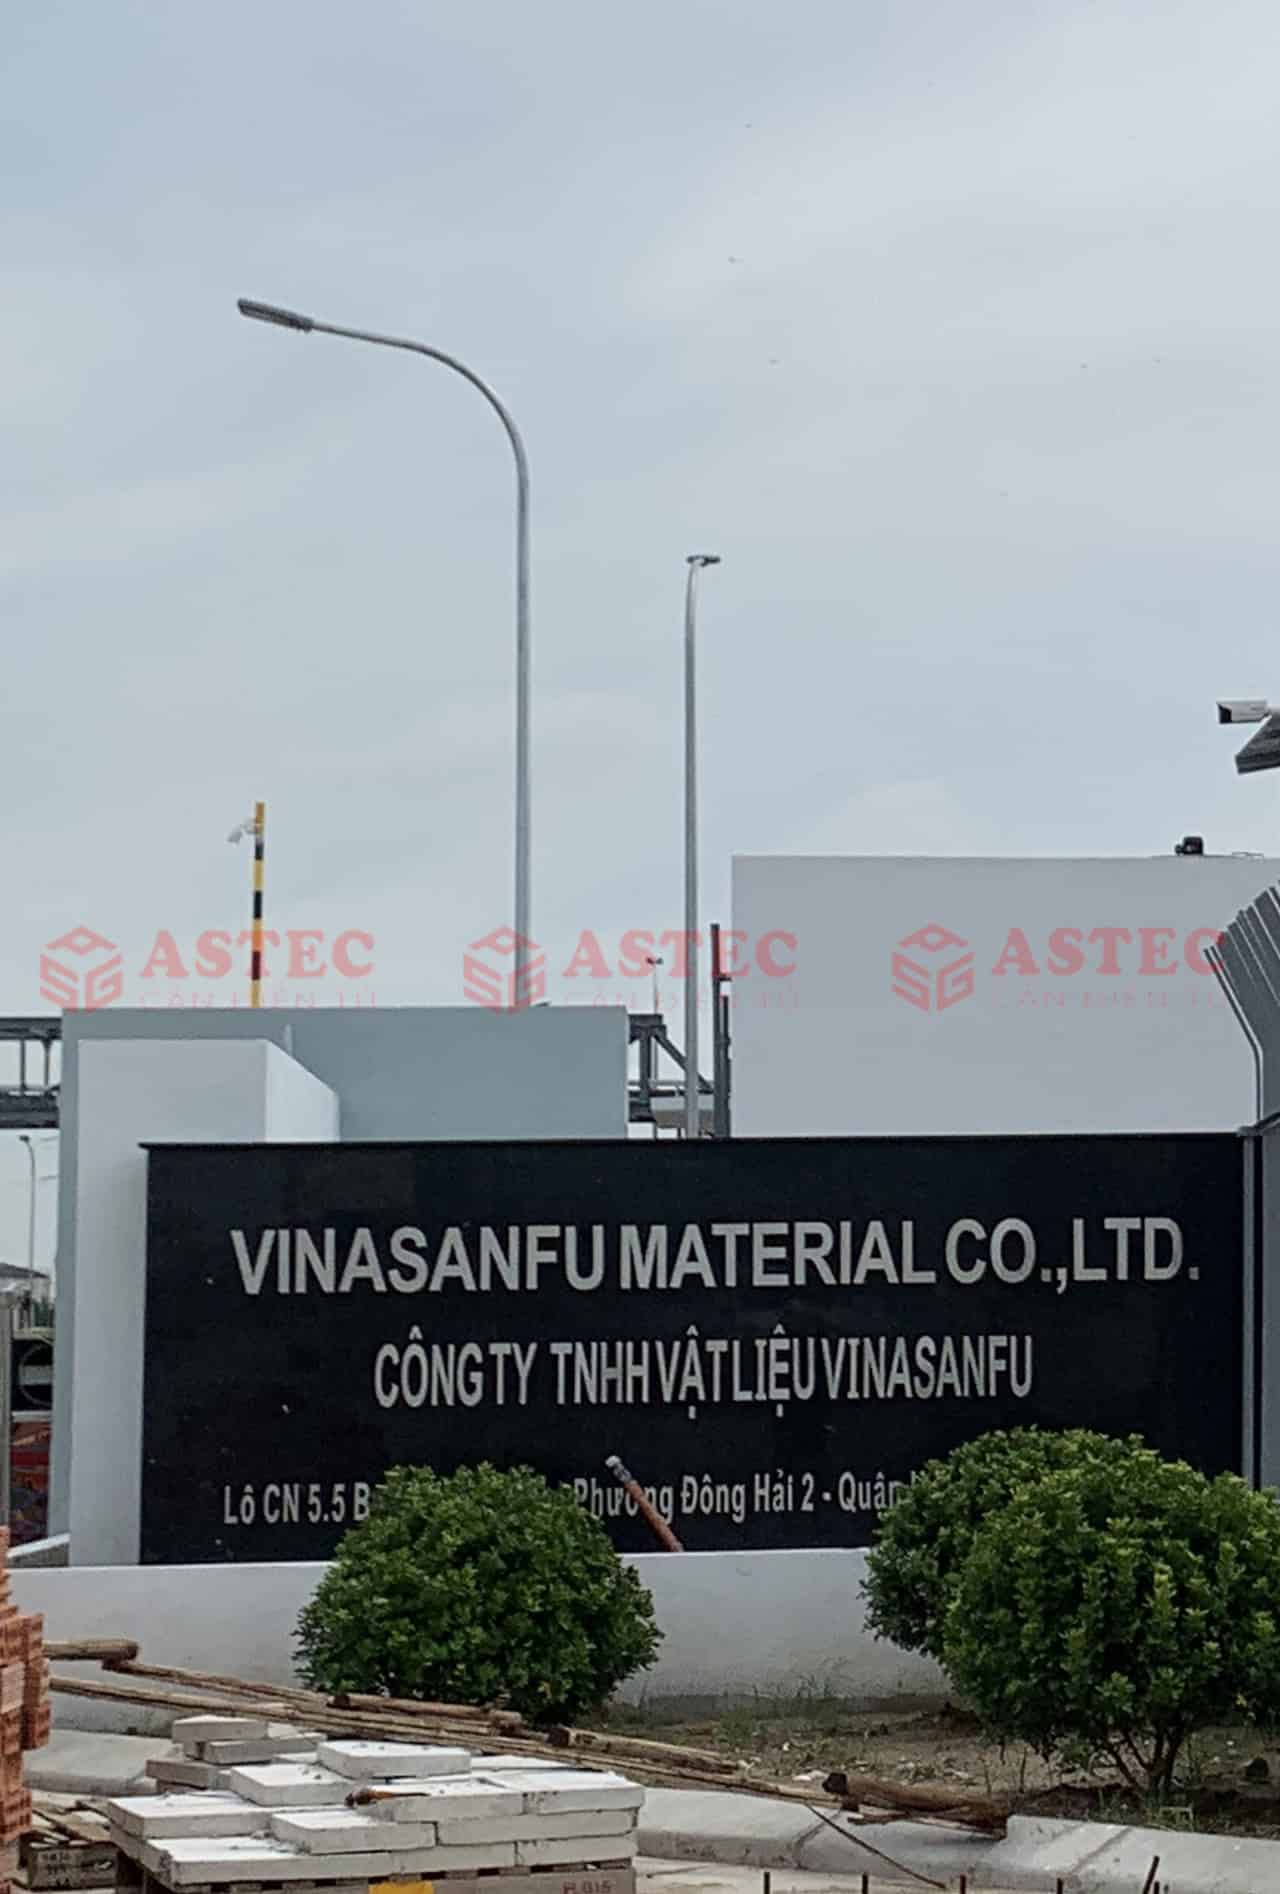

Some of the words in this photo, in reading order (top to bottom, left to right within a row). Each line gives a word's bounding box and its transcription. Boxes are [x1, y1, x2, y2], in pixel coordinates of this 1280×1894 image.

[230, 1224, 606, 1295] VINASANFU
[620, 1220, 938, 1290] MATERIAL
[374, 1325, 484, 1409] CÔNG
[489, 1342, 538, 1405] TY
[550, 1340, 649, 1405] TNHH
[655, 1324, 729, 1420] VẬT
[732, 1323, 815, 1418] LIỆU
[820, 1335, 1033, 1399] VINASANFU
[223, 1484, 255, 1525] Lô
[263, 1483, 300, 1524] CN
[680, 1473, 746, 1524] Đông
[754, 1468, 793, 1512] Hải
[801, 1472, 815, 1512] 2
